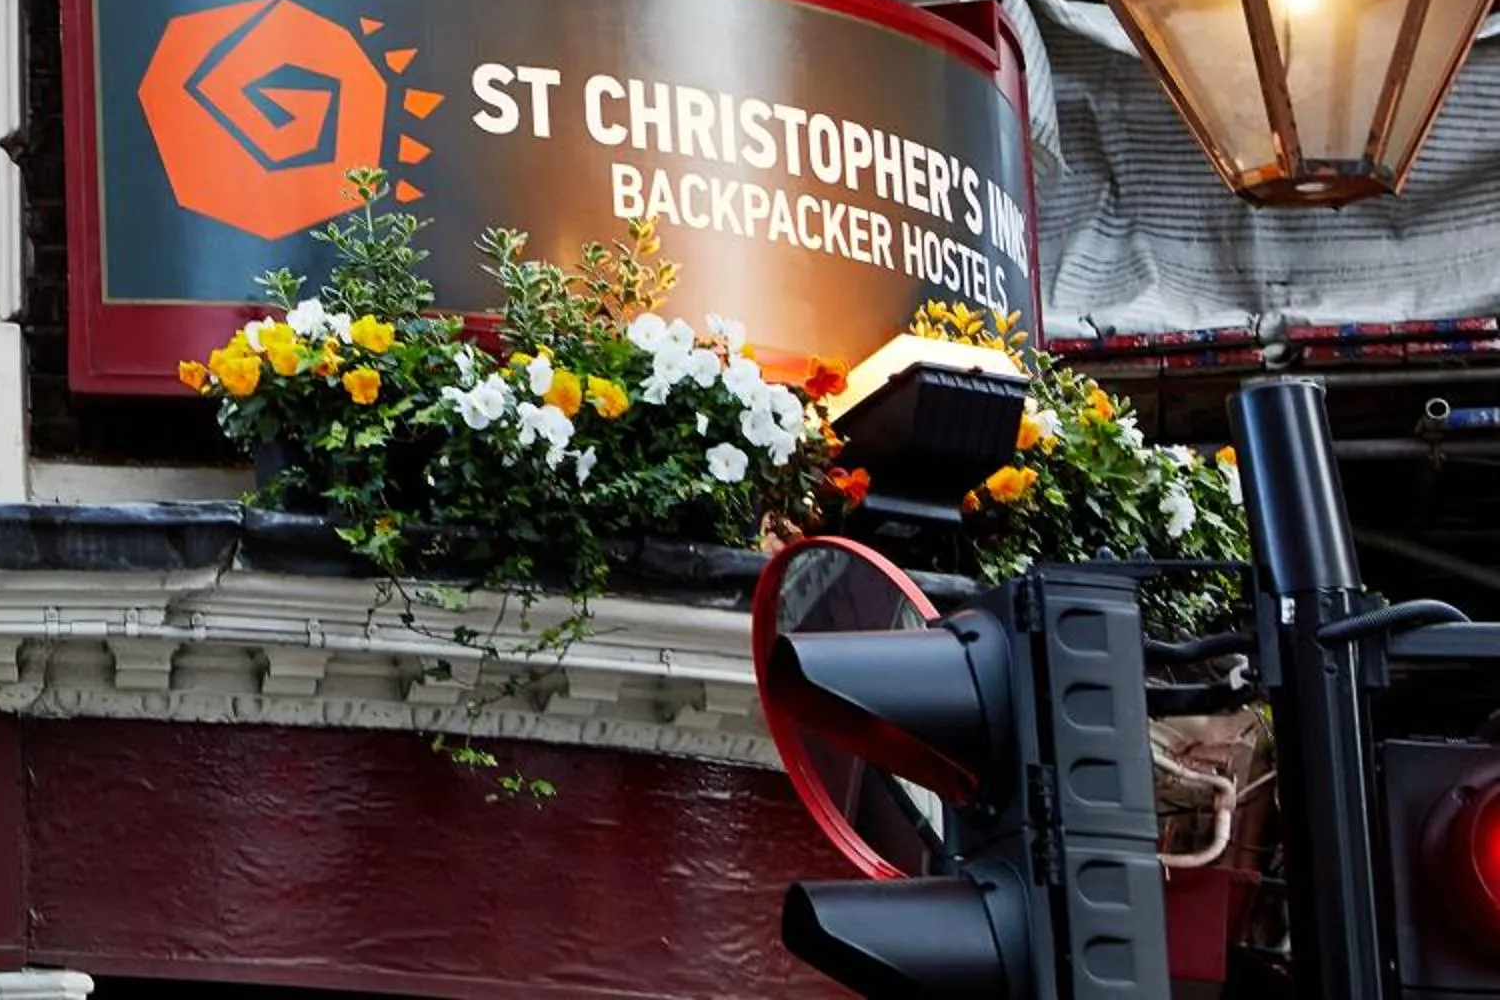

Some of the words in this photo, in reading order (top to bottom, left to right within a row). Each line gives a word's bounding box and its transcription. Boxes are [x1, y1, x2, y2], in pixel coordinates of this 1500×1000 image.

[472, 63, 560, 138] ST
[584, 74, 984, 236] CHRISTOPHER'S
[611, 164, 895, 271] BACKPACKER
[901, 220, 1009, 319] HOSTELS
